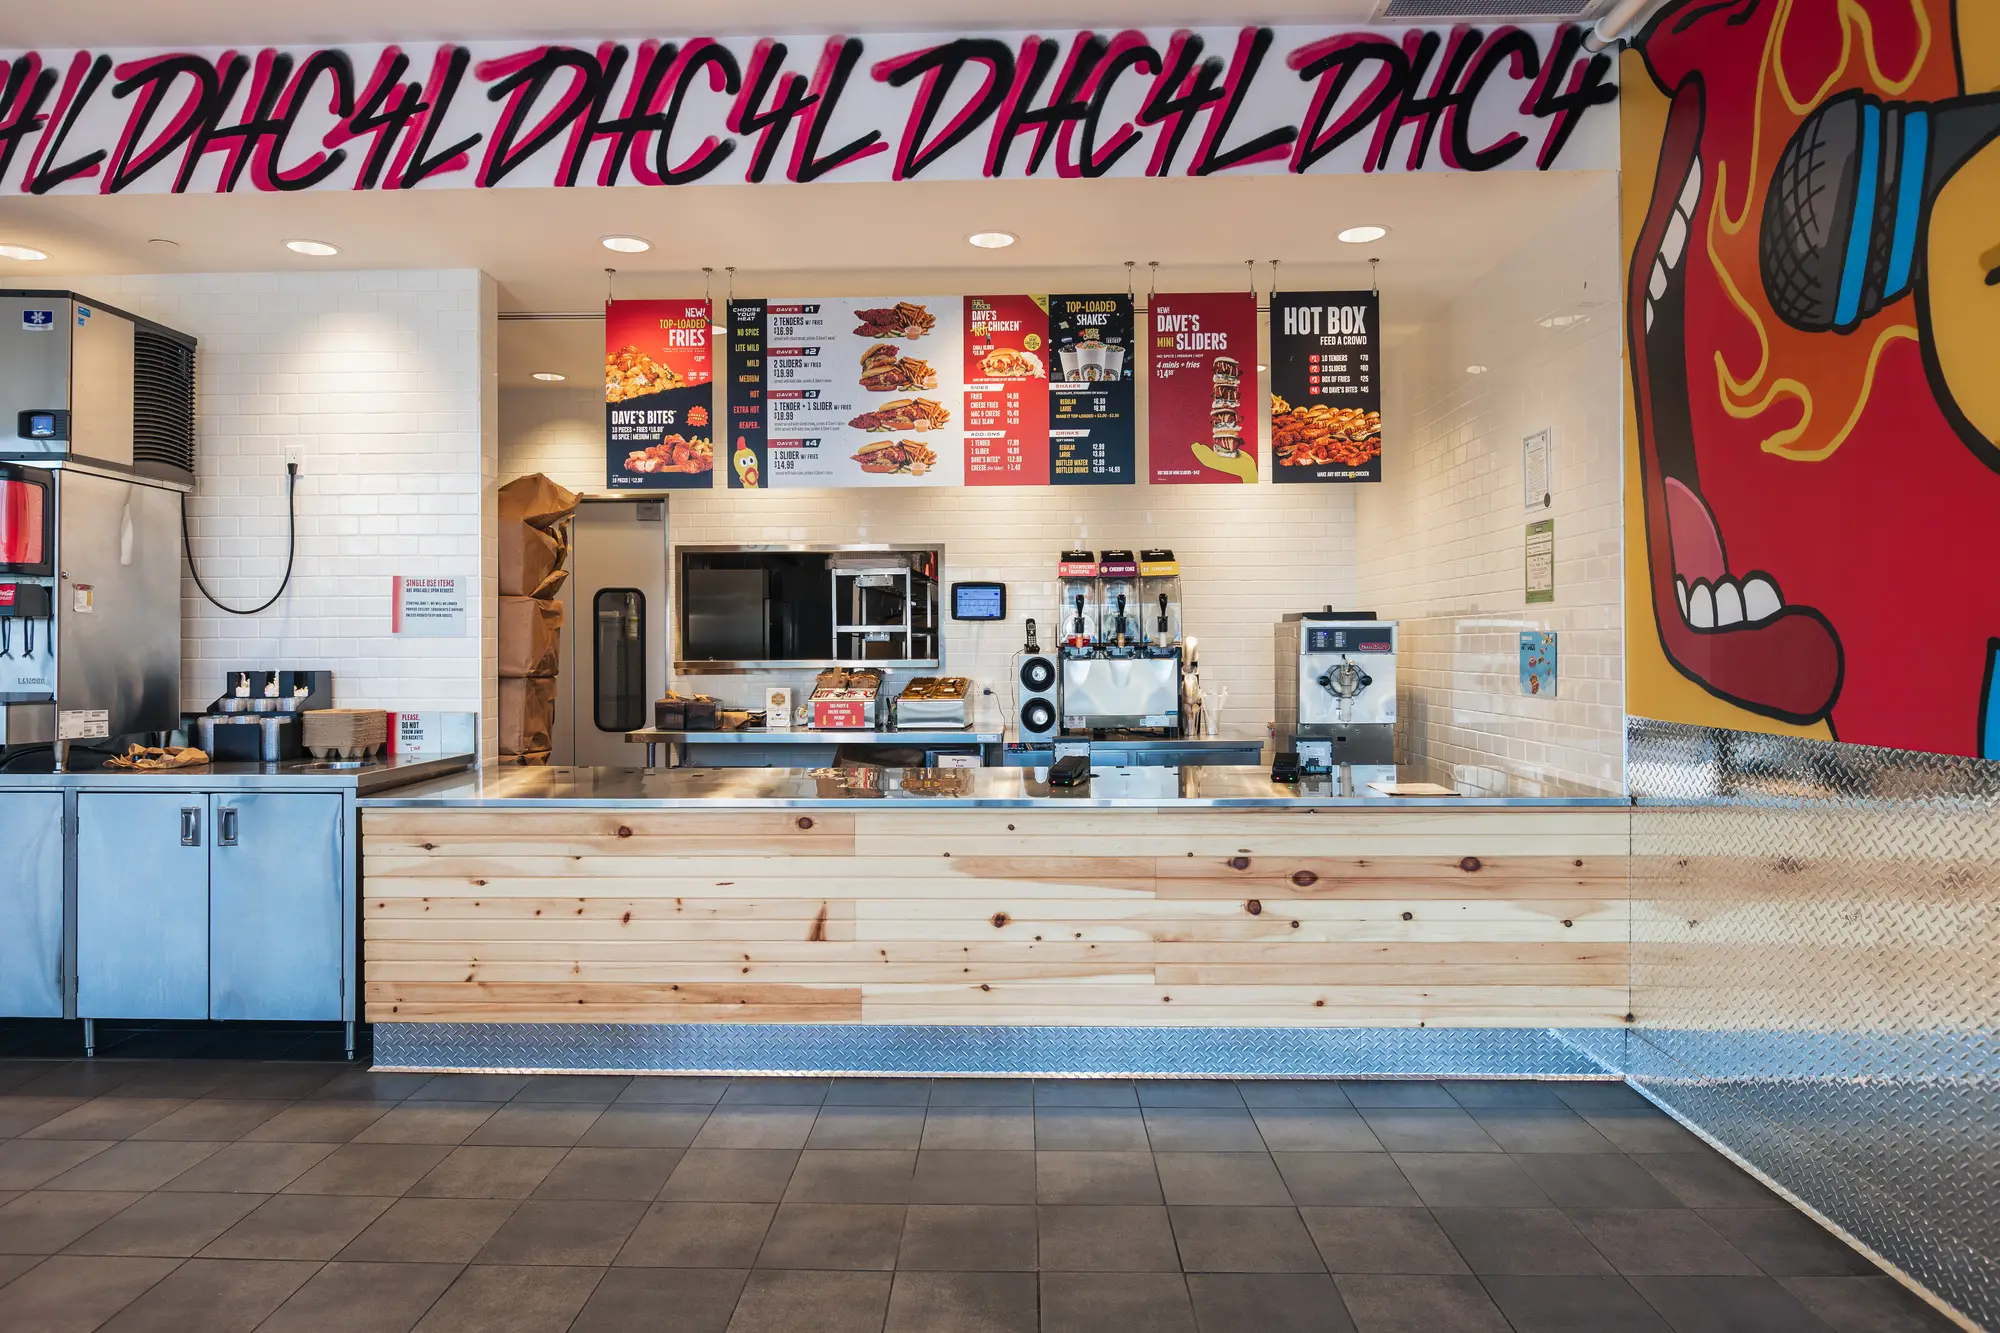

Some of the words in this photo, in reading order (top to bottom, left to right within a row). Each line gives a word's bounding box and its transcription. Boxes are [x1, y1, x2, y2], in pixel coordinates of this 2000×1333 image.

[1066, 301, 1116, 312] TOP-LOADED
[685, 308, 705, 317] NEW!
[972, 310, 997, 320] DAVE'S
[660, 319, 705, 328] TOP-LOADED
[774, 317, 777, 325] 2
[780, 317, 804, 325] TENDERS
[1077, 314, 1108, 325] SHAKES
[1157, 314, 1200, 332] DAVE'S
[1284, 307, 1322, 335] HOT
[1328, 306, 1366, 334] BOX
[988, 321, 1020, 331] CHICKEN
[737, 328, 744, 336] NO
[745, 328, 759, 336] SPICE
[774, 327, 793, 335] $16.99
[669, 329, 705, 346] FRIES
[1157, 337, 1174, 347] MINI
[1176, 333, 1227, 350] SLIDERS
[1320, 336, 1336, 345] FEED
[1337, 336, 1342, 345] A
[1343, 336, 1367, 345] CROWD
[774, 360, 777, 368] 2
[779, 359, 802, 368] SLIDERS
[1162, 361, 1179, 369] minis
[774, 369, 793, 377] $19.99
[774, 402, 777, 410] 1
[780, 402, 800, 410] TENDER
[808, 402, 811, 410] 1
[813, 402, 832, 410] SLIDER
[612, 411, 645, 424] DAVE'S
[648, 410, 674, 424] BITES
[774, 451, 778, 459] 1
[780, 451, 799, 459] SLIDER
[774, 461, 794, 469] $14.99
[406, 579, 425, 587] SINGLE
[427, 579, 436, 587] USE
[438, 579, 454, 587] ITEMS
